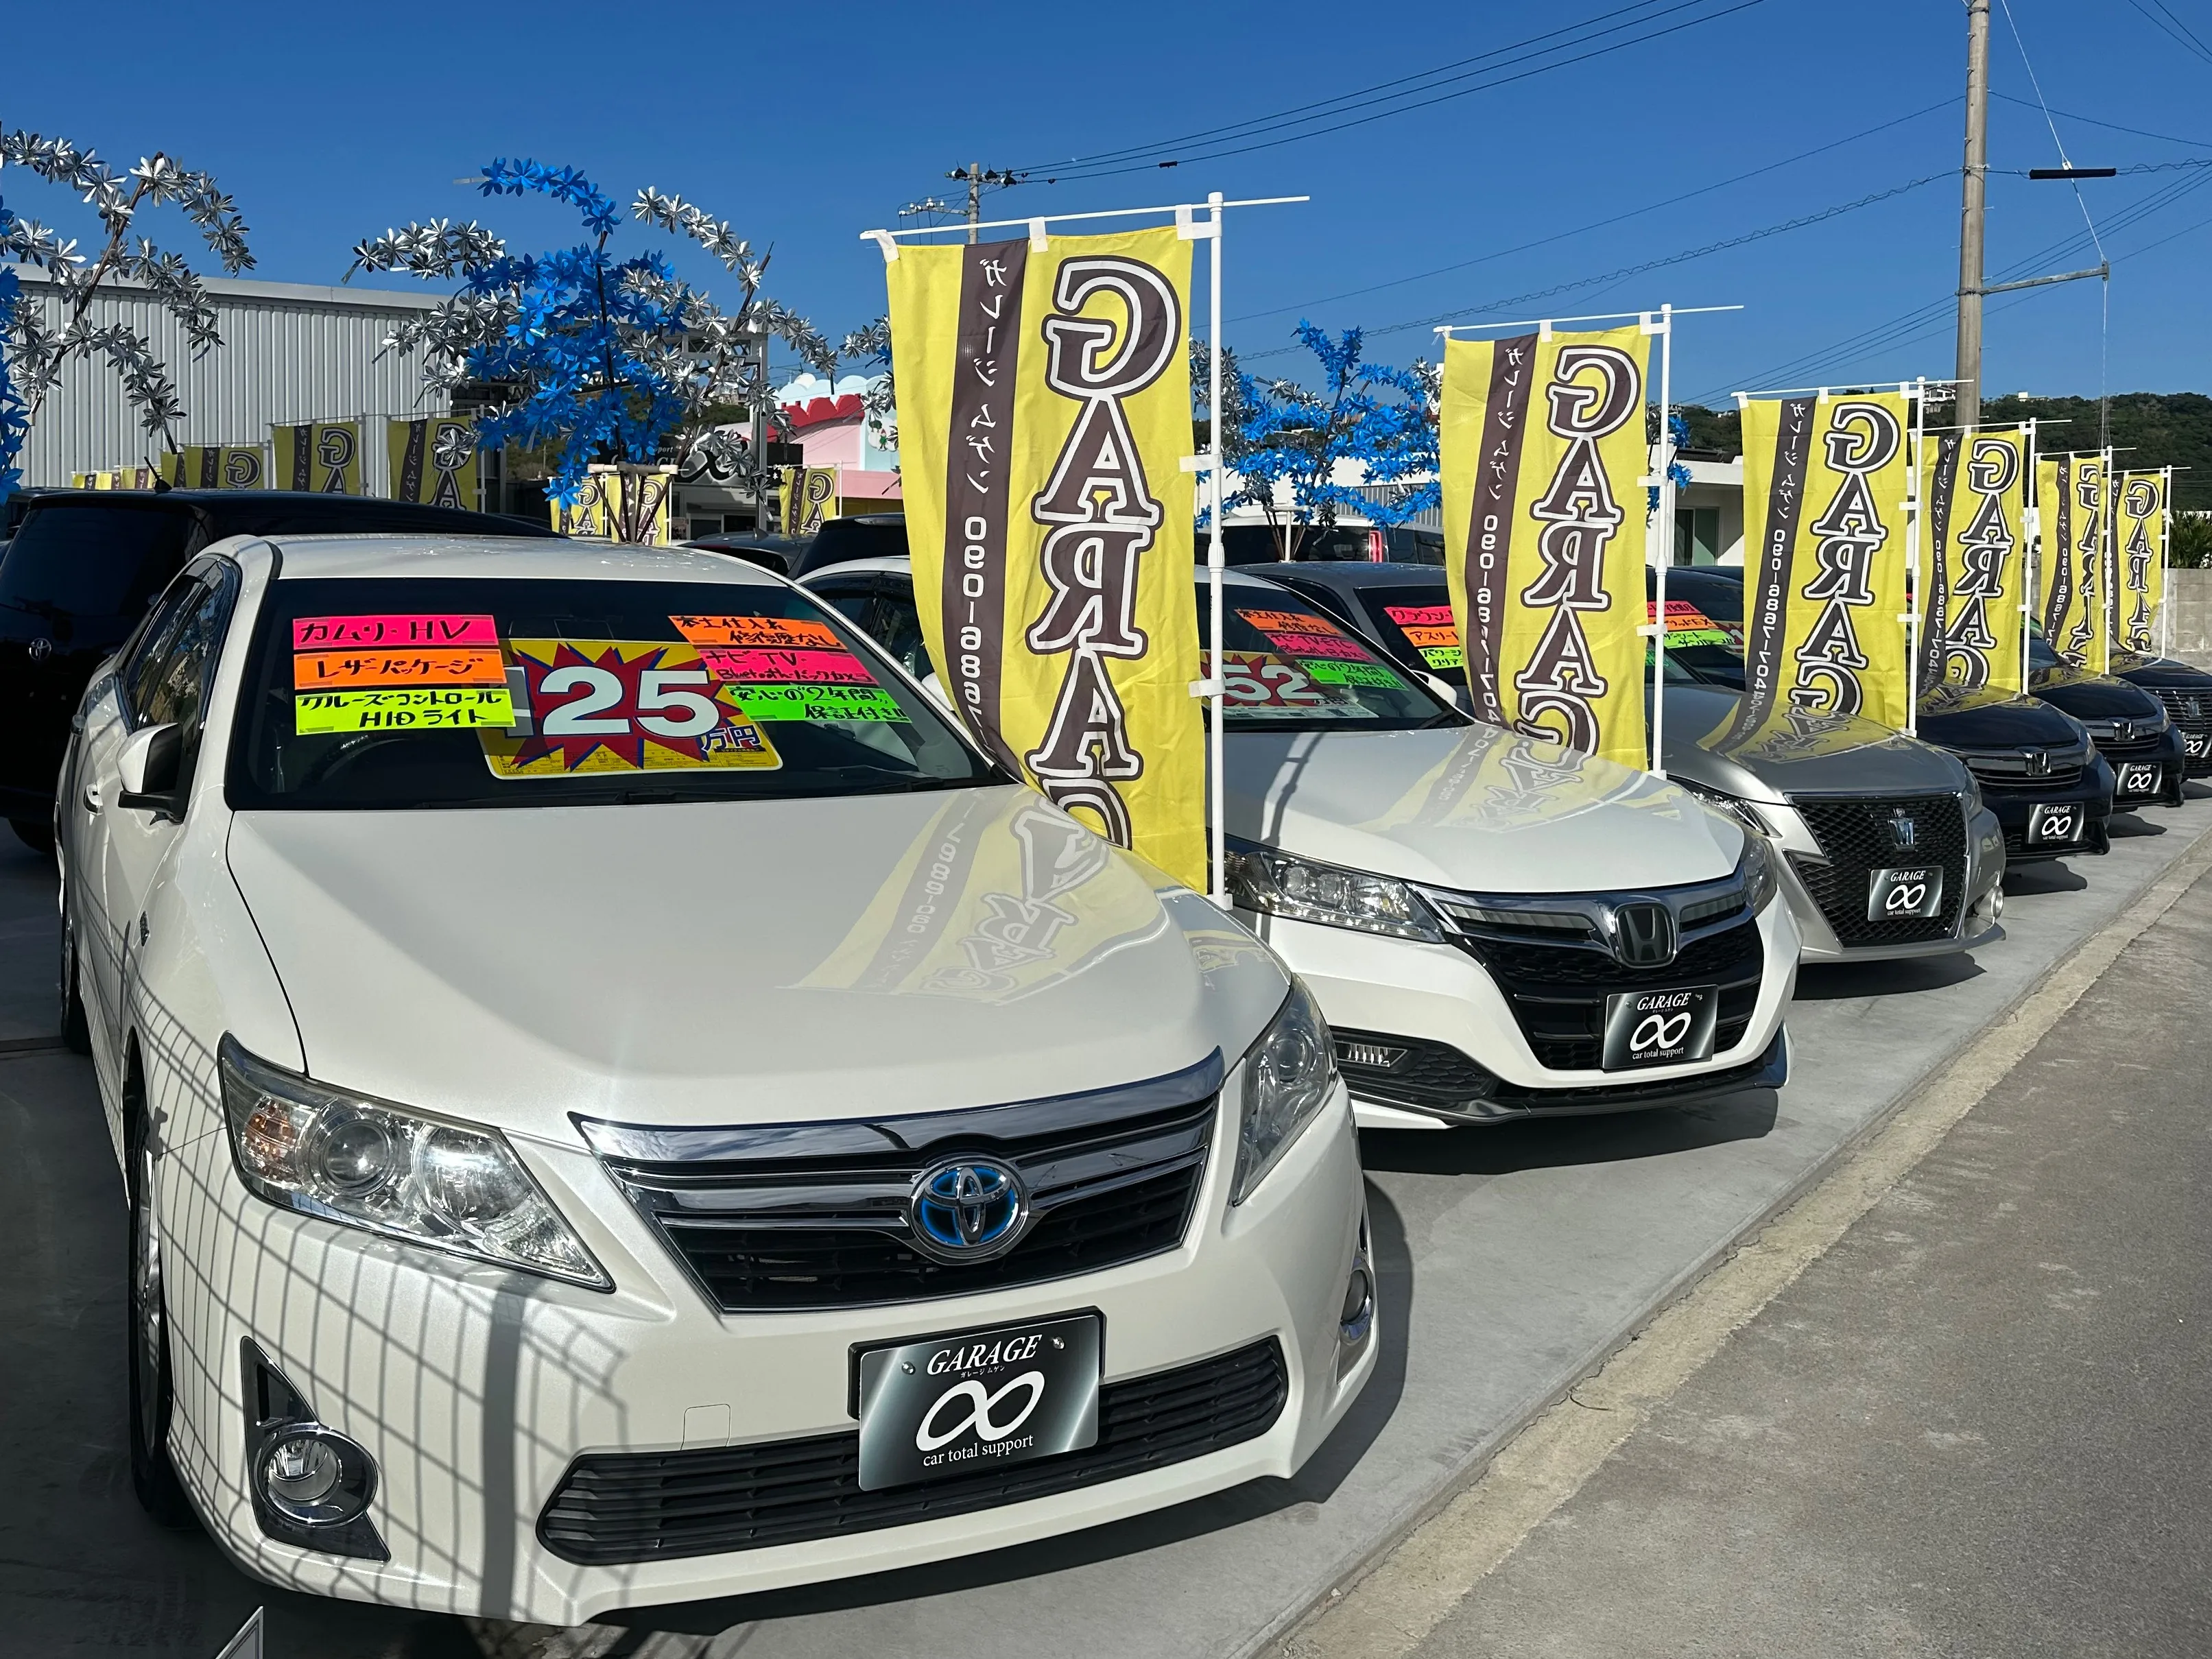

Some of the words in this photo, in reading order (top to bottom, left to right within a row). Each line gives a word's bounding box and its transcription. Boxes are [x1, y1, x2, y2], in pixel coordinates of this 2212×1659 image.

[1890, 870, 1926, 882] GARAGE
[1637, 992, 1692, 1011] GARAGE
[1644, 1049, 1658, 1058] total
[1660, 1047, 1684, 1058] support
[926, 1334, 1043, 1375] GARAGE
[923, 1451, 944, 1467] car
[948, 1443, 978, 1462] total
[982, 1434, 1034, 1459] support
